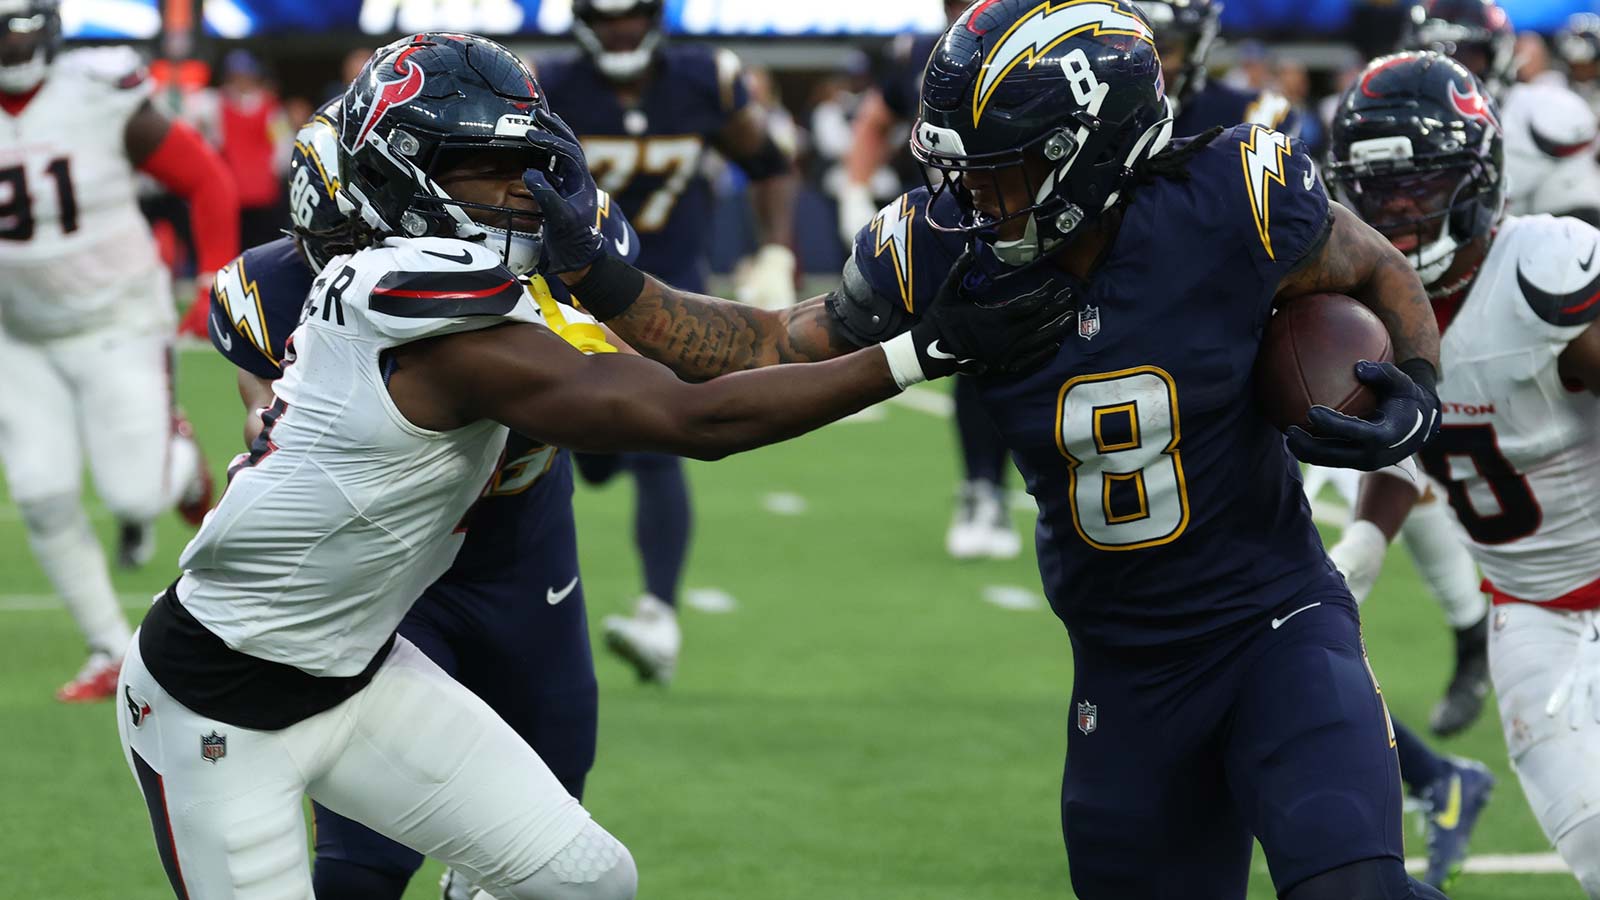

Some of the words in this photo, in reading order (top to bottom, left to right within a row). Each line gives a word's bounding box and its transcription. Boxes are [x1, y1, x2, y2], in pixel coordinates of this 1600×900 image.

[1060, 48, 1099, 106] 8
[505, 117, 535, 126] TEXA
[0, 157, 78, 242] 91
[290, 165, 320, 228] 86
[576, 135, 703, 232] 77
[1441, 402, 1497, 416] STON
[1055, 365, 1190, 551] 8
[1418, 422, 1543, 545] 0
